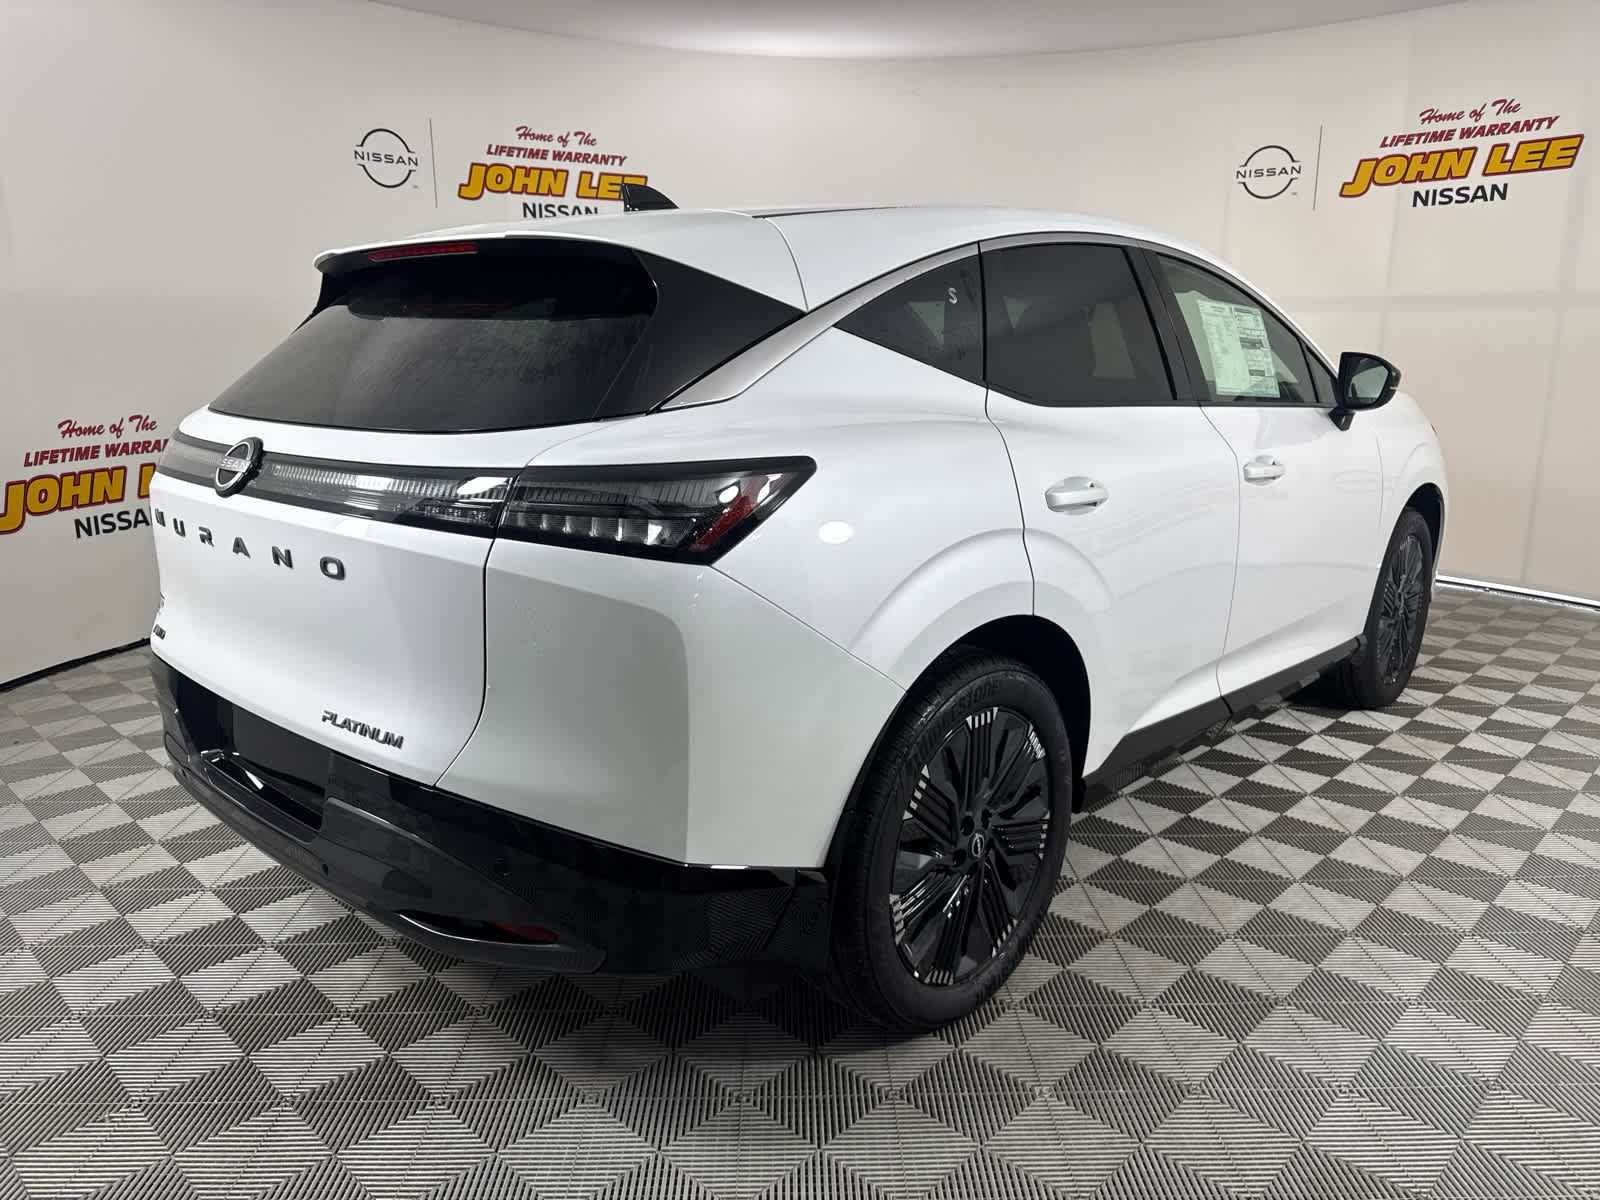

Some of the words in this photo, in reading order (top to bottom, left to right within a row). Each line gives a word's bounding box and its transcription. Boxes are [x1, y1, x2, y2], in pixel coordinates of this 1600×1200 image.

[1419, 108, 1464, 125] Home
[1469, 103, 1485, 122] of
[1491, 99, 1521, 117] The
[515, 126, 553, 144] Home
[557, 131, 571, 148] of
[573, 131, 597, 146] The
[1380, 128, 1458, 149] LIFETIME
[1459, 115, 1560, 142] WARRANTY
[354, 149, 419, 167] NISSAN
[486, 143, 550, 161] LIFETIME
[552, 151, 628, 167] WARRANTY
[1339, 147, 1478, 198] JOHN
[1481, 134, 1585, 177] LEE
[458, 162, 568, 200] JOHN
[1235, 164, 1302, 180] NISSAN
[1412, 182, 1509, 208] NISSAN
[57, 418, 105, 439] Home
[109, 417, 124, 438] of
[128, 414, 157, 433] The
[24, 443, 100, 468] LIFETIME
[0, 465, 128, 535] JOHN
[74, 508, 151, 539] NISSA
[154, 508, 346, 582] MURANO
[321, 710, 405, 750] PLATINUM
